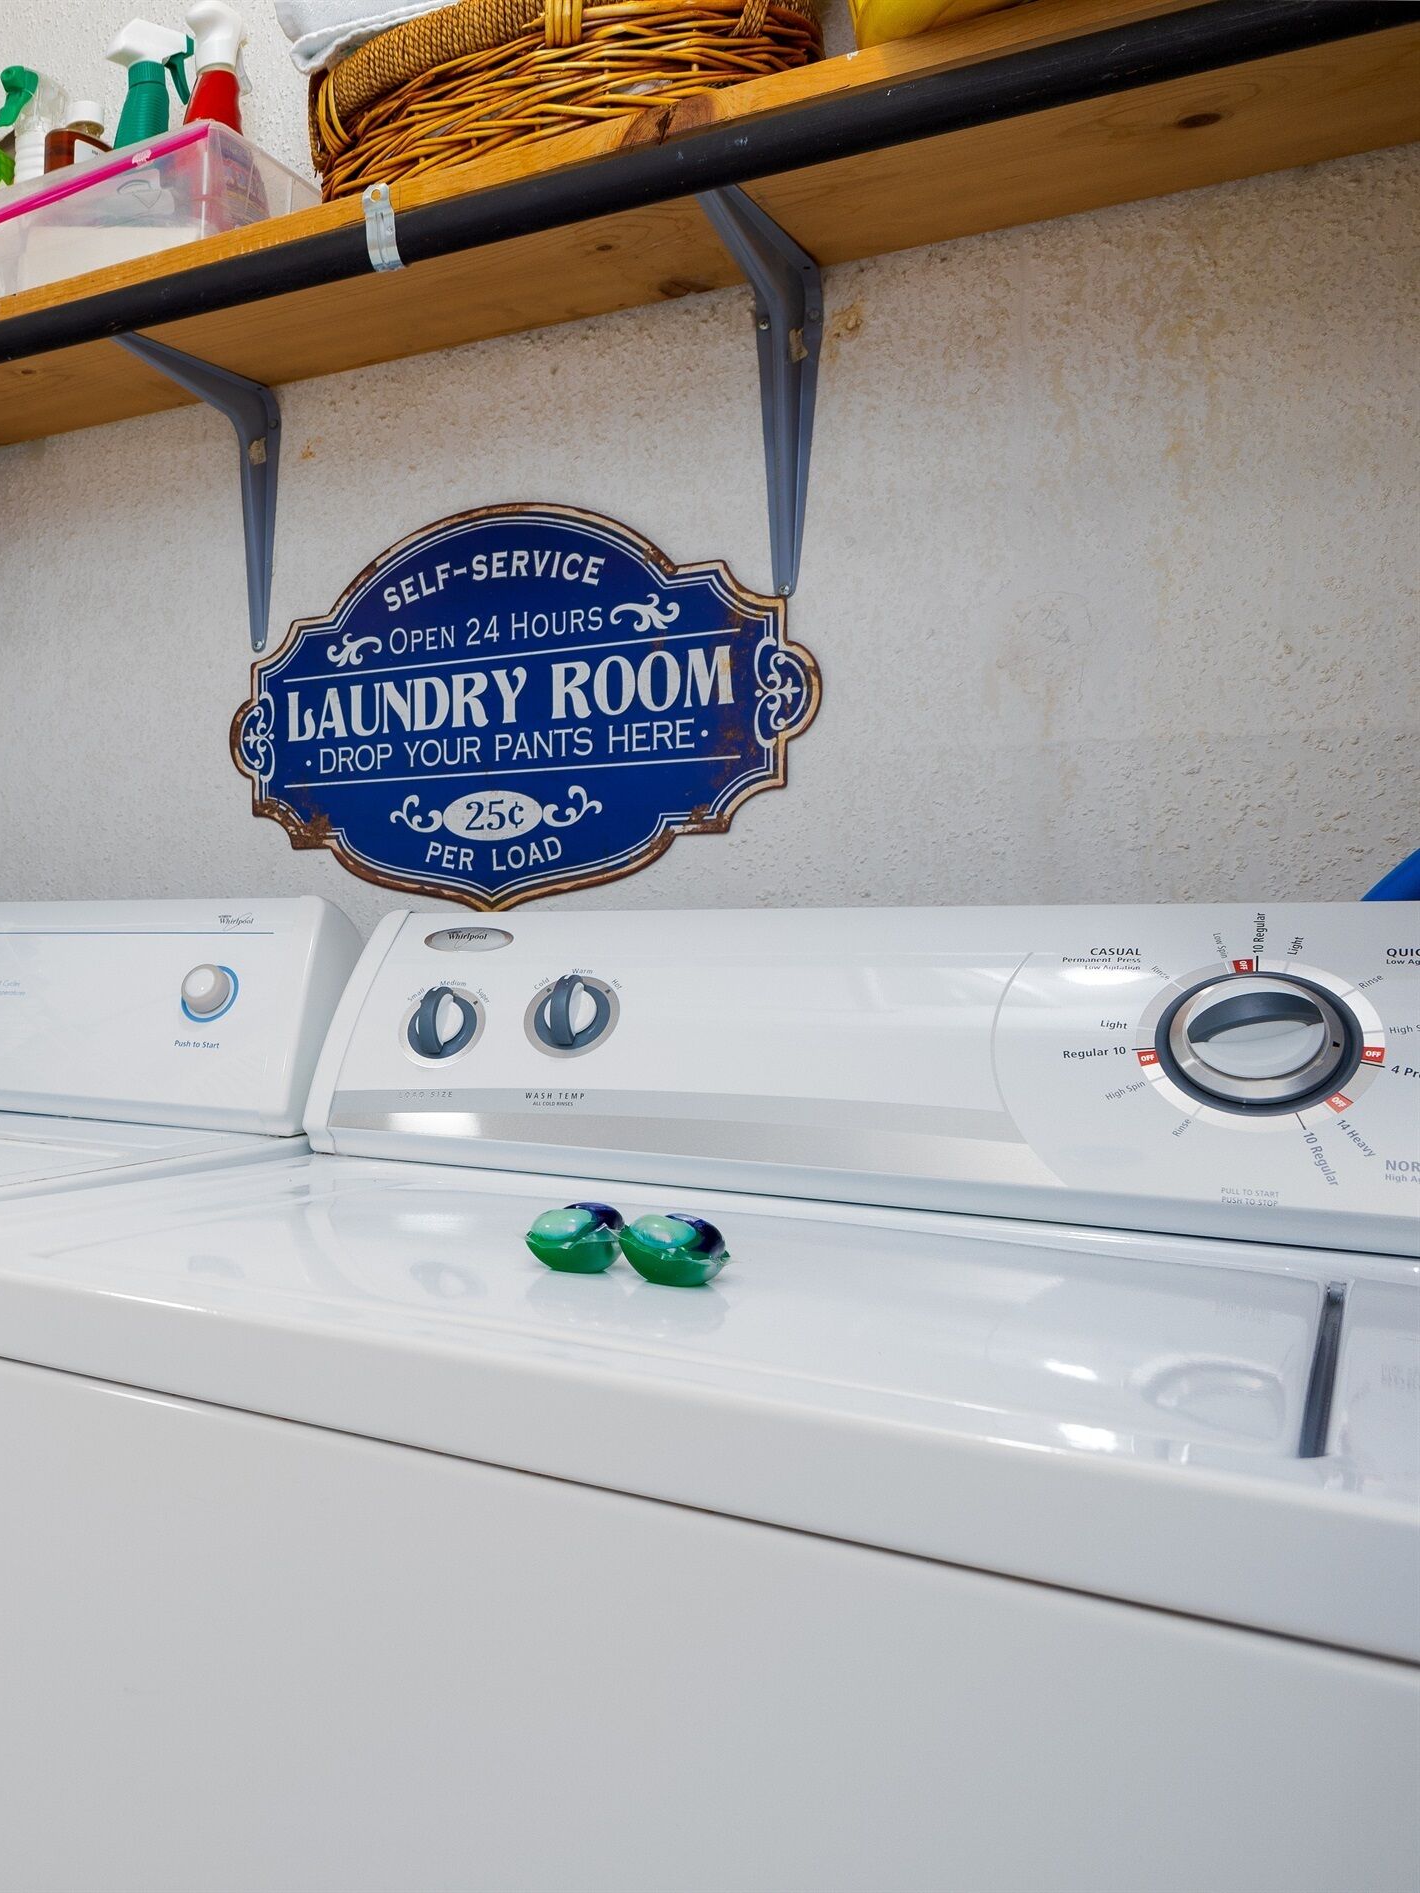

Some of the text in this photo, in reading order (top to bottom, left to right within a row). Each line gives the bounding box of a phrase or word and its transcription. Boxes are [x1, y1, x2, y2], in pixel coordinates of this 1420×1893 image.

[383, 549, 606, 612] SELF-SERVICE
[466, 615, 501, 647] 24
[287, 645, 735, 743] LAUNDRY ROOM
[319, 718, 696, 775] DROP YOUR PANTS HERE
[465, 800, 525, 831] 25¢
[425, 836, 562, 872] PER LOAD
[447, 932, 488, 941] Whirlpool
[1252, 912, 1268, 953] 10 Regular
[1090, 947, 1142, 956] CASUAL
[1286, 936, 1305, 956] Light
[1239, 960, 1249, 971] OFF
[534, 977, 550, 990] Cold
[1358, 974, 1384, 989] Rinse
[407, 987, 425, 1002] Small
[1100, 1019, 1128, 1030] Light
[1389, 1023, 1413, 1035] High
[174, 1040, 191, 1048] Push
[1063, 1046, 1126, 1060] Regular 10
[1140, 1054, 1155, 1062] OFF
[1365, 1050, 1382, 1058] OFF
[1391, 1065, 1400, 1074] 4
[525, 1092, 585, 1100] WASH TEMP
[1105, 1080, 1147, 1101] High Spin
[1331, 1096, 1347, 1108] OFF
[1172, 1118, 1192, 1138] Rinse
[1336, 1119, 1377, 1158] 14 Heavy
[1303, 1132, 1340, 1186] 10 Regular
[1385, 1173, 1408, 1183] High
[1255, 1190, 1280, 1198] START
[1221, 1196, 1279, 1207] PUSH TO STOP
